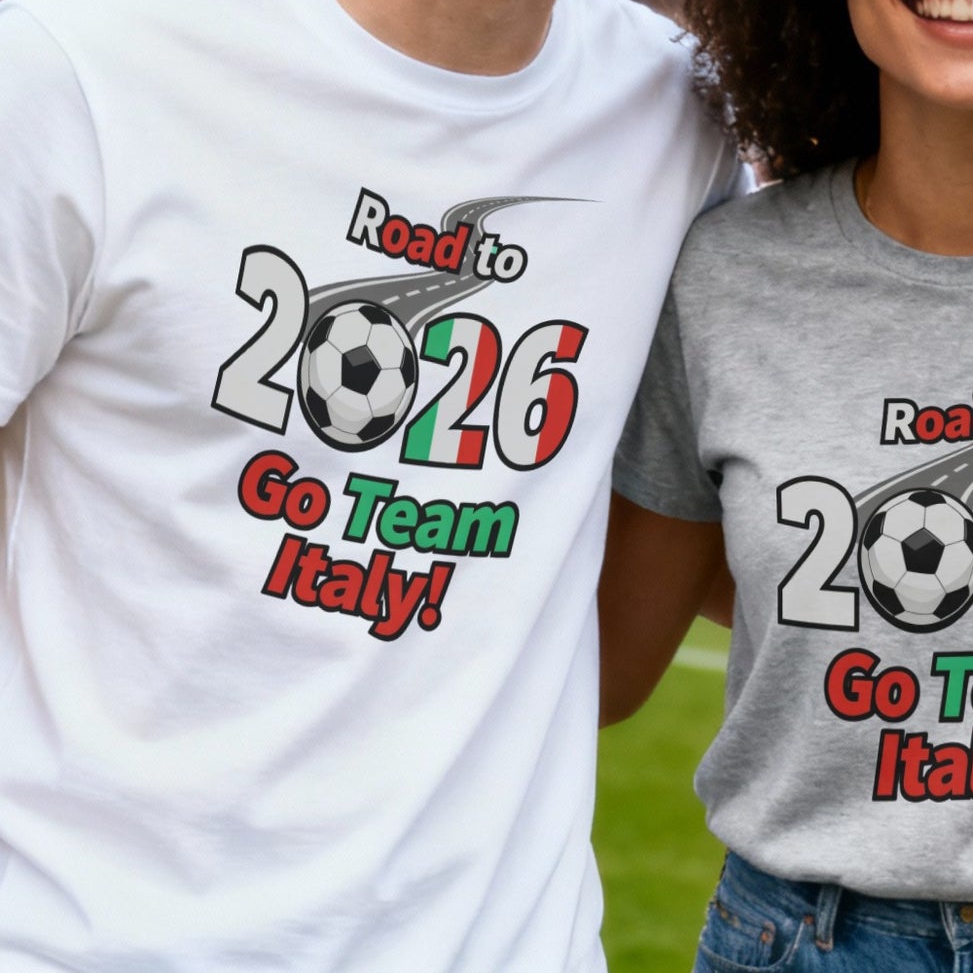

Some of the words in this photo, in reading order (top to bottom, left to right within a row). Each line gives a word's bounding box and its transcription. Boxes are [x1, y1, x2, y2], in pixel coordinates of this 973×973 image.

[346, 187, 475, 275] Road
[473, 233, 528, 283] to
[237, 450, 331, 531] Go
[342, 472, 519, 557] Team
[261, 533, 456, 641] Italy!
[824, 648, 920, 722] Go
